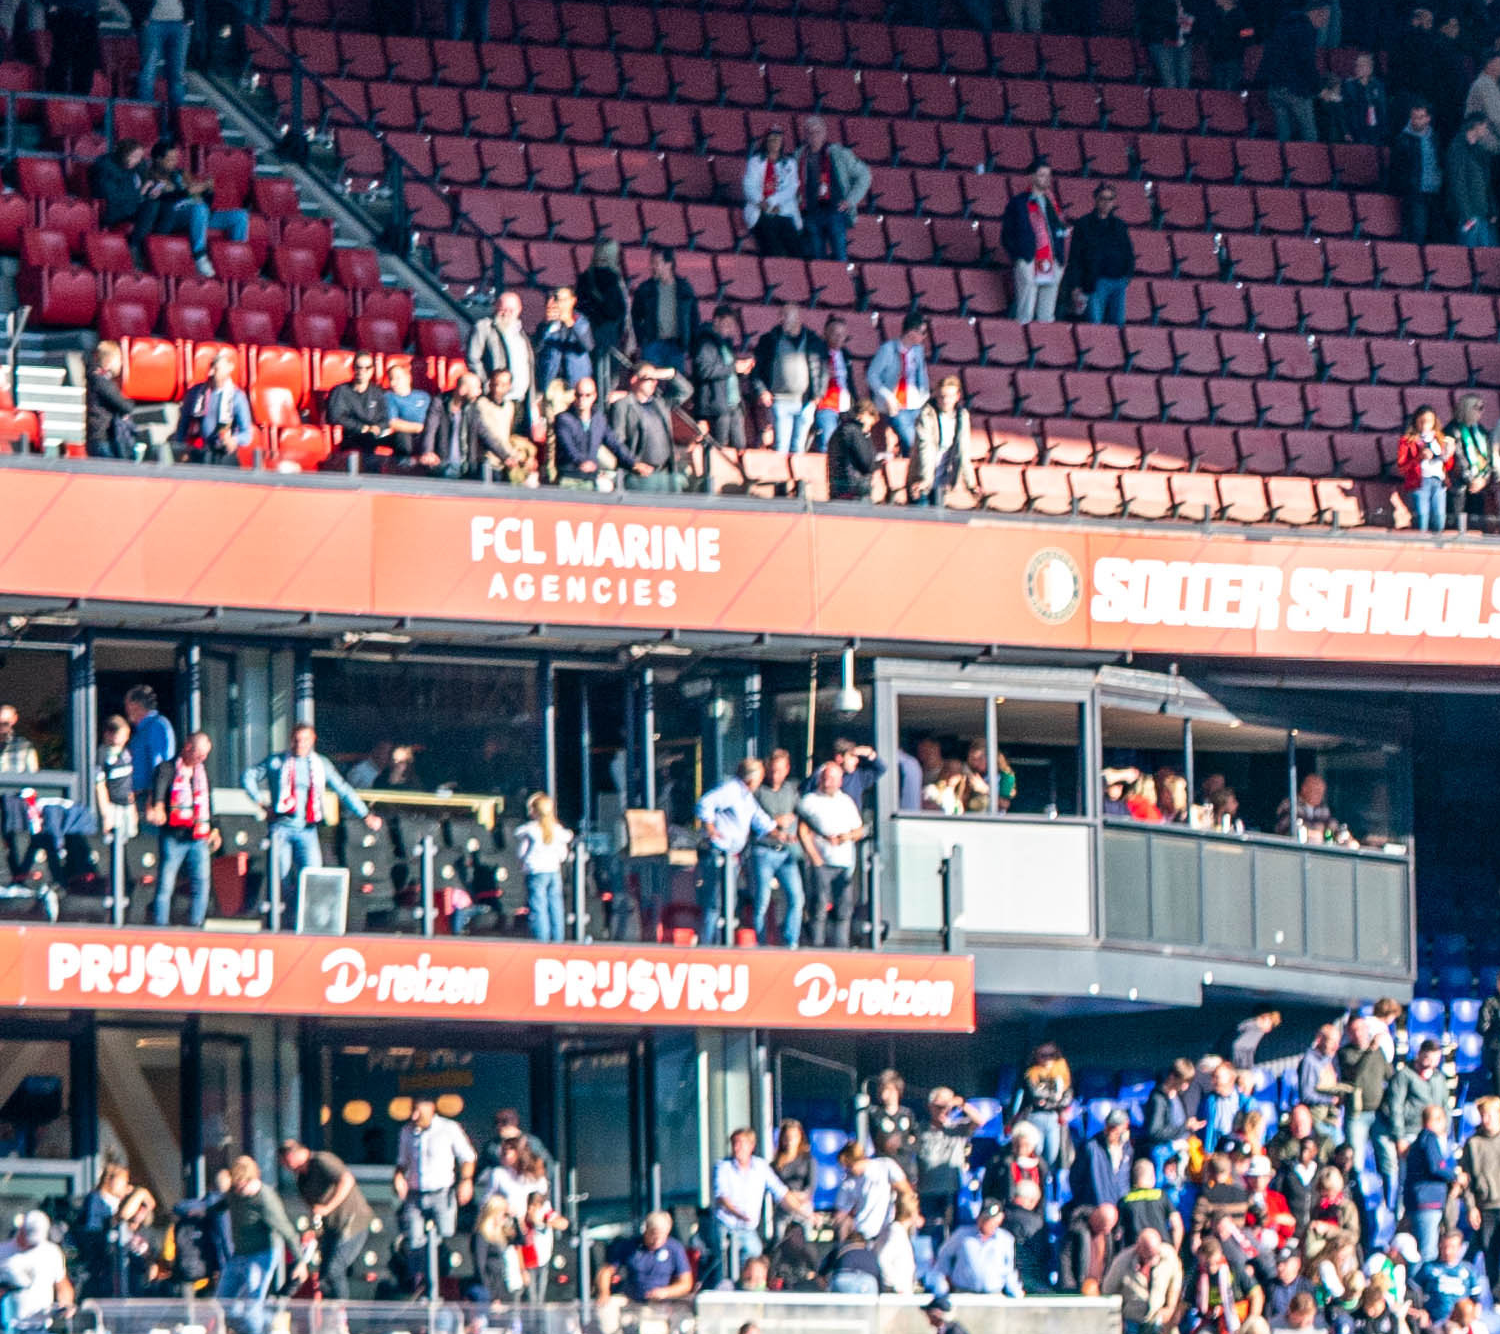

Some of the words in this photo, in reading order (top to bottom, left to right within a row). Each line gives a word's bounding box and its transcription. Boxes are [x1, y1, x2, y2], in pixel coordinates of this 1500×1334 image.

[471, 516, 546, 564] FCL
[555, 520, 722, 573] MARINE
[488, 573, 677, 607] AGENCIES
